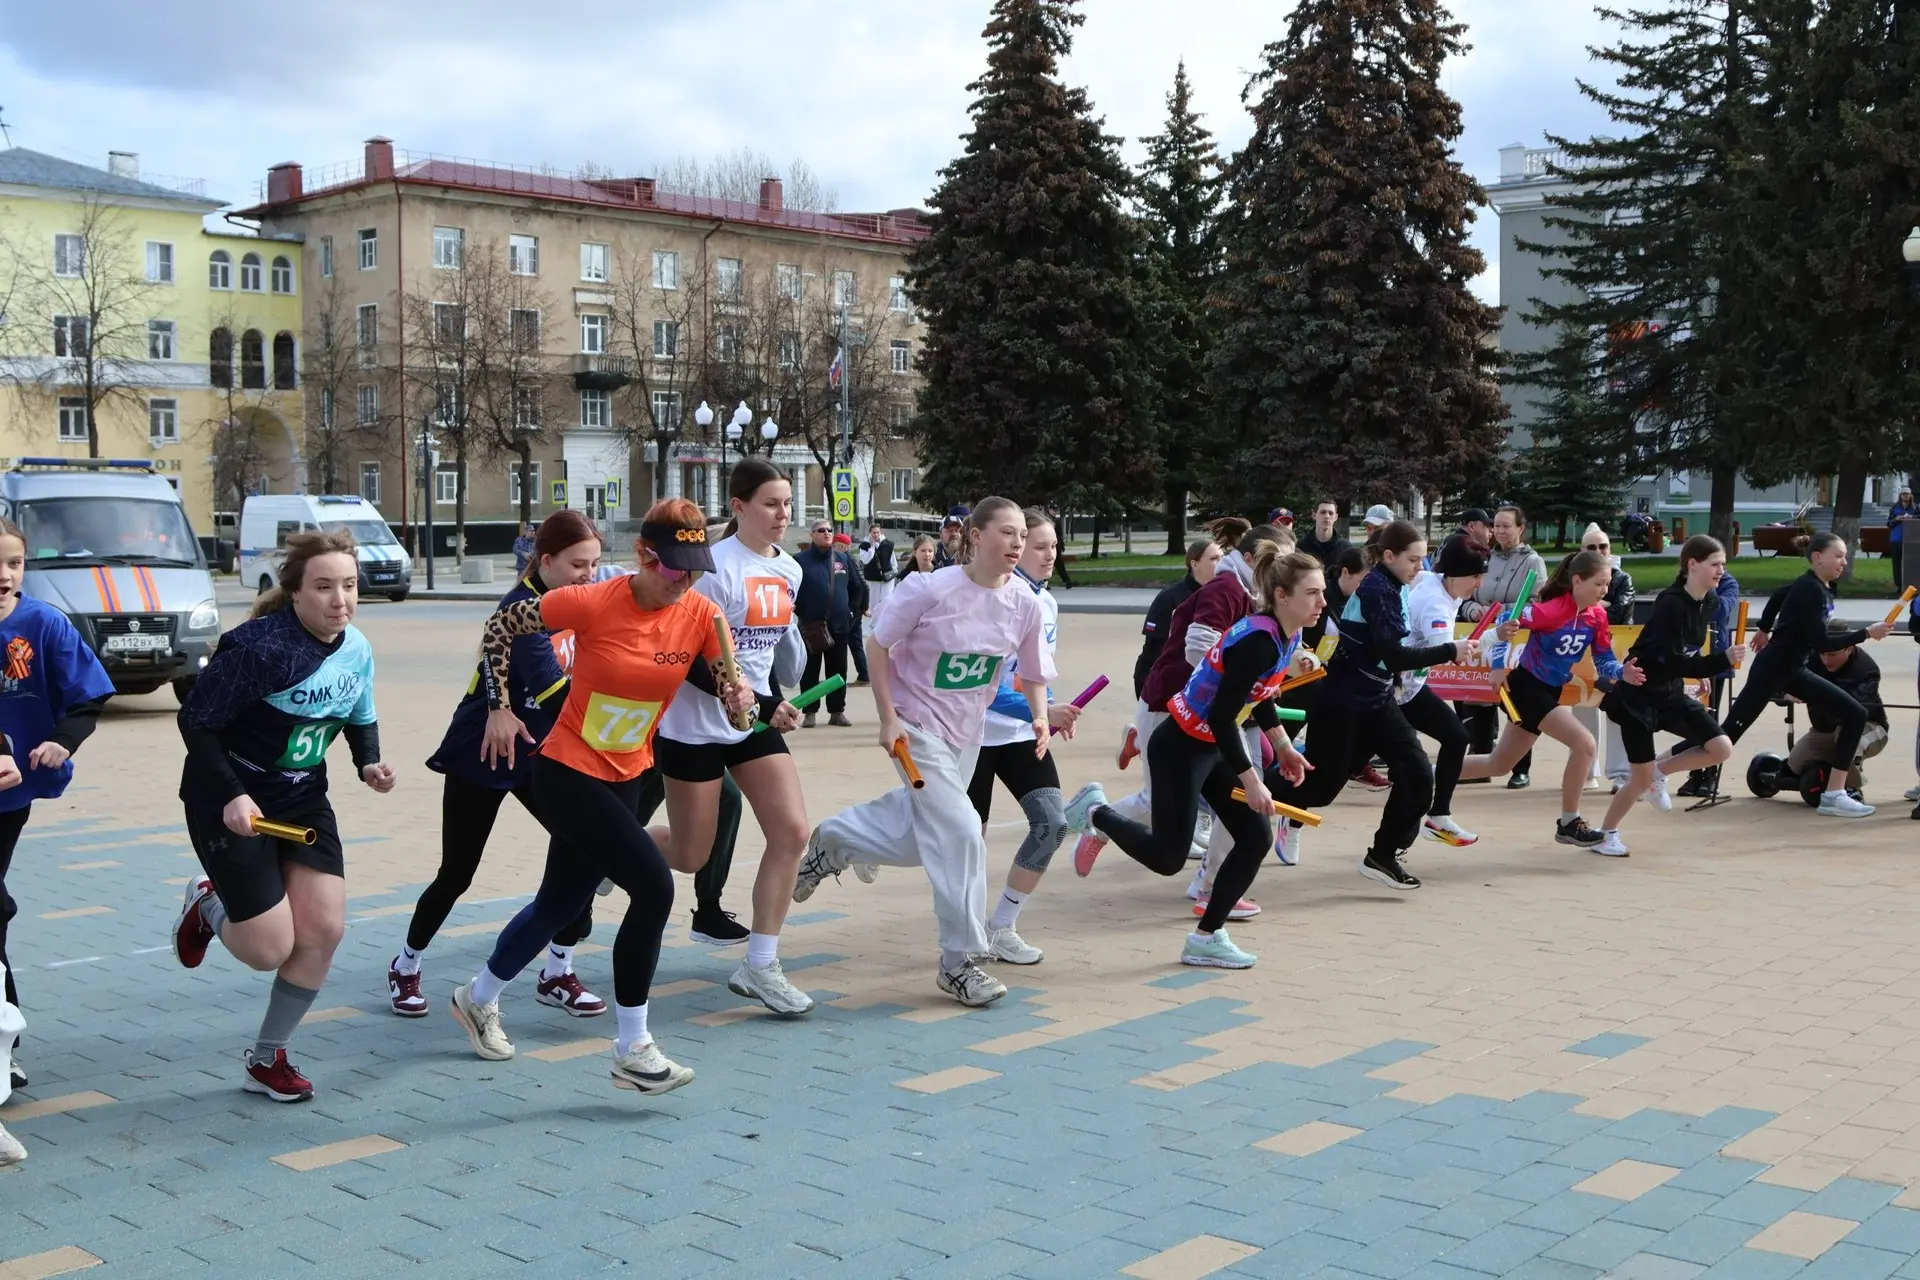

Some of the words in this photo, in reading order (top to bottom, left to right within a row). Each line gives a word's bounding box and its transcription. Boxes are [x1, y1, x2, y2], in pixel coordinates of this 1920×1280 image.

[840, 503, 848, 512] 20
[755, 583, 779, 619] 17
[155, 636, 166, 644] 50
[1556, 634, 1587, 656] 35
[483, 651, 493, 678] UNDER
[945, 653, 988, 683] 54
[1428, 668, 1457, 680] СКАЯ
[1458, 670, 1489, 681] ЭСТАФ
[487, 679, 494, 688] BY
[489, 688, 497, 700] ME
[290, 684, 333, 706] СМК
[598, 703, 651, 744] 72
[292, 724, 334, 763] 51
